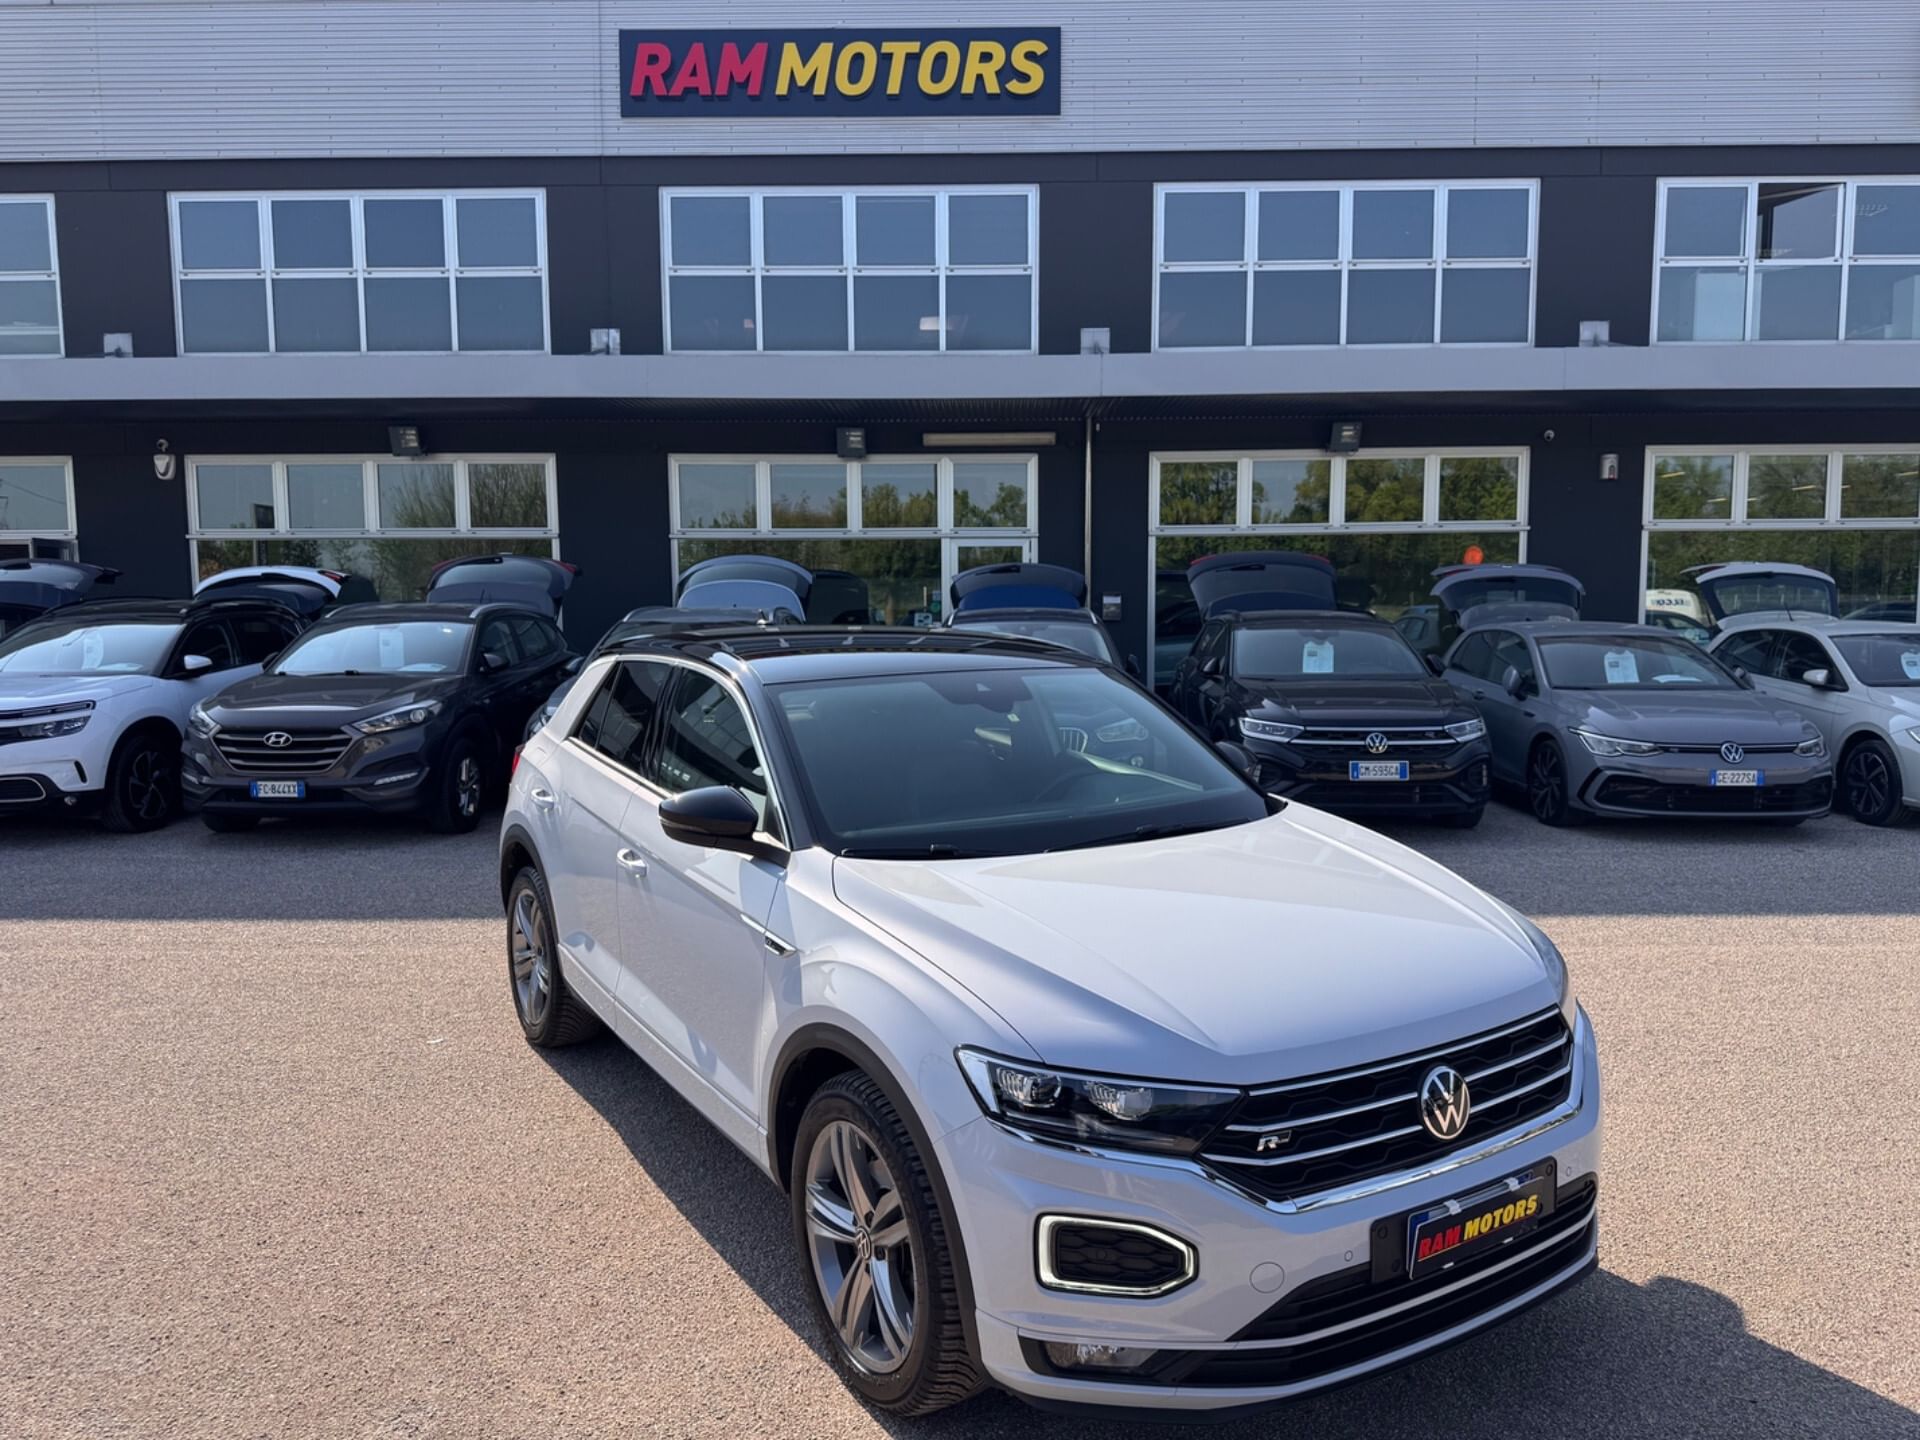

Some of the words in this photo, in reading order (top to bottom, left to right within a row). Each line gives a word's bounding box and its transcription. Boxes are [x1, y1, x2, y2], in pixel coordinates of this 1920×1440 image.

[629, 42, 768, 97] RAM
[775, 39, 1049, 97] MOTORS
[1418, 1225, 1462, 1260] RAM
[1463, 1193, 1539, 1241] MOTORS
